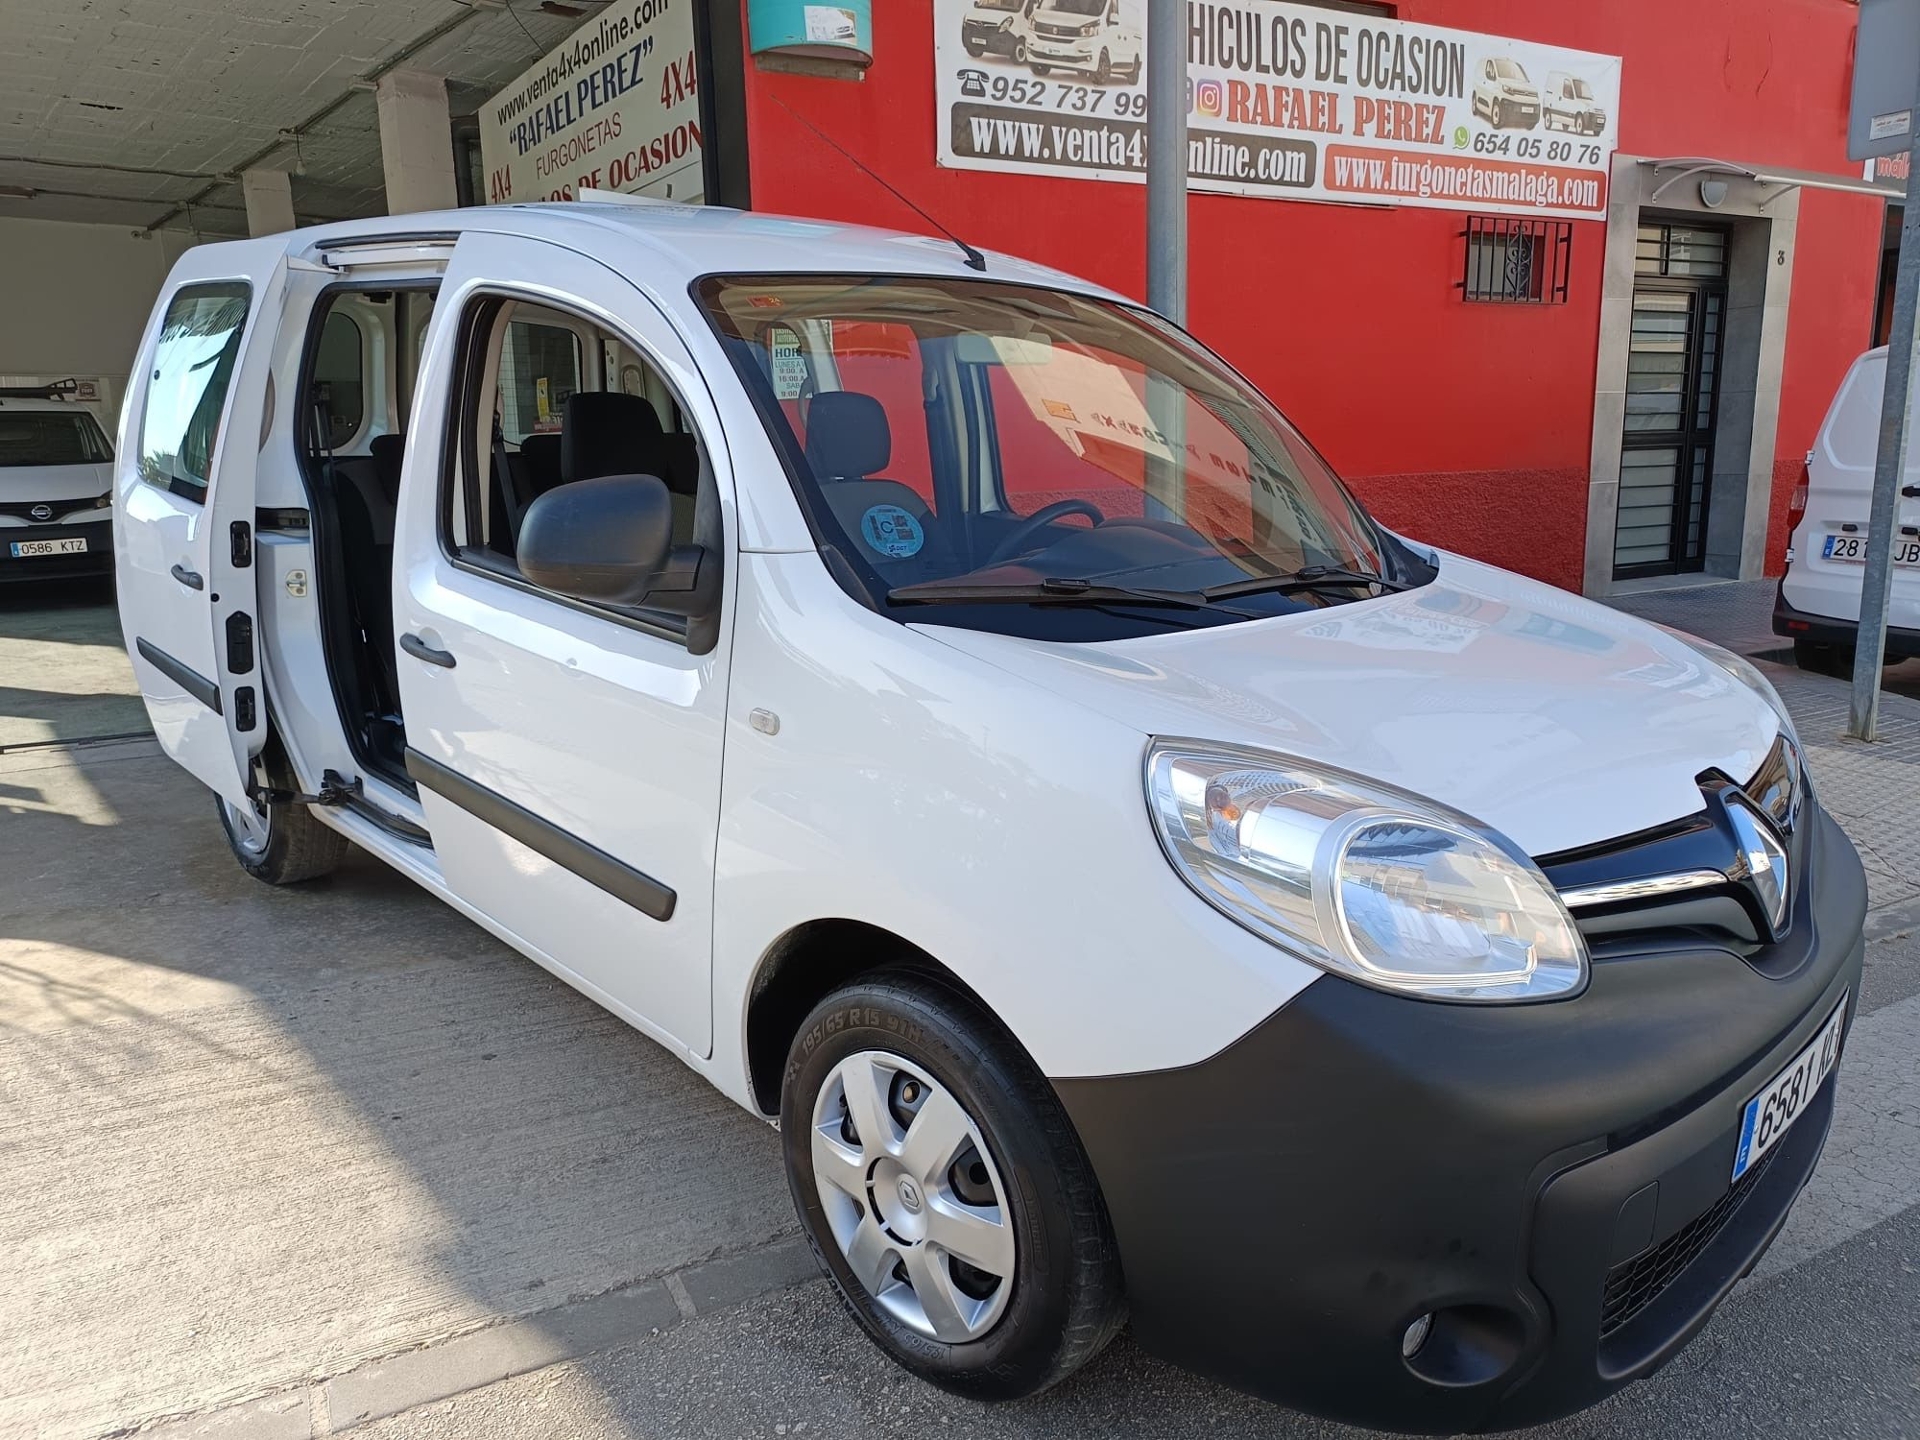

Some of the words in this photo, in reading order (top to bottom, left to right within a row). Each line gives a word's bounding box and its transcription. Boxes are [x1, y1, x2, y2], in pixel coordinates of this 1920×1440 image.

[497, 0, 669, 126] www.venta4x4online.com
[1315, 22, 1349, 84] DE
[1357, 29, 1465, 99] OCASION
[990, 76, 1047, 106] 952
[1056, 84, 1107, 113] 737
[1227, 79, 1343, 134] RAFAEL
[1353, 95, 1446, 146] PEREZ
[536, 112, 622, 180] FURGONETAS
[609, 119, 702, 190] OCASION
[1473, 132, 1511, 156] 654
[1516, 137, 1541, 160] 05
[1547, 141, 1572, 162] 80
[1577, 144, 1601, 165] 76
[1333, 154, 1599, 207] www.furgonetasmalaga.com
[21, 542, 53, 555] 0586
[60, 540, 84, 552] KTZ
[803, 1010, 844, 1053] 195/65
[1758, 1051, 1816, 1149] 6581
